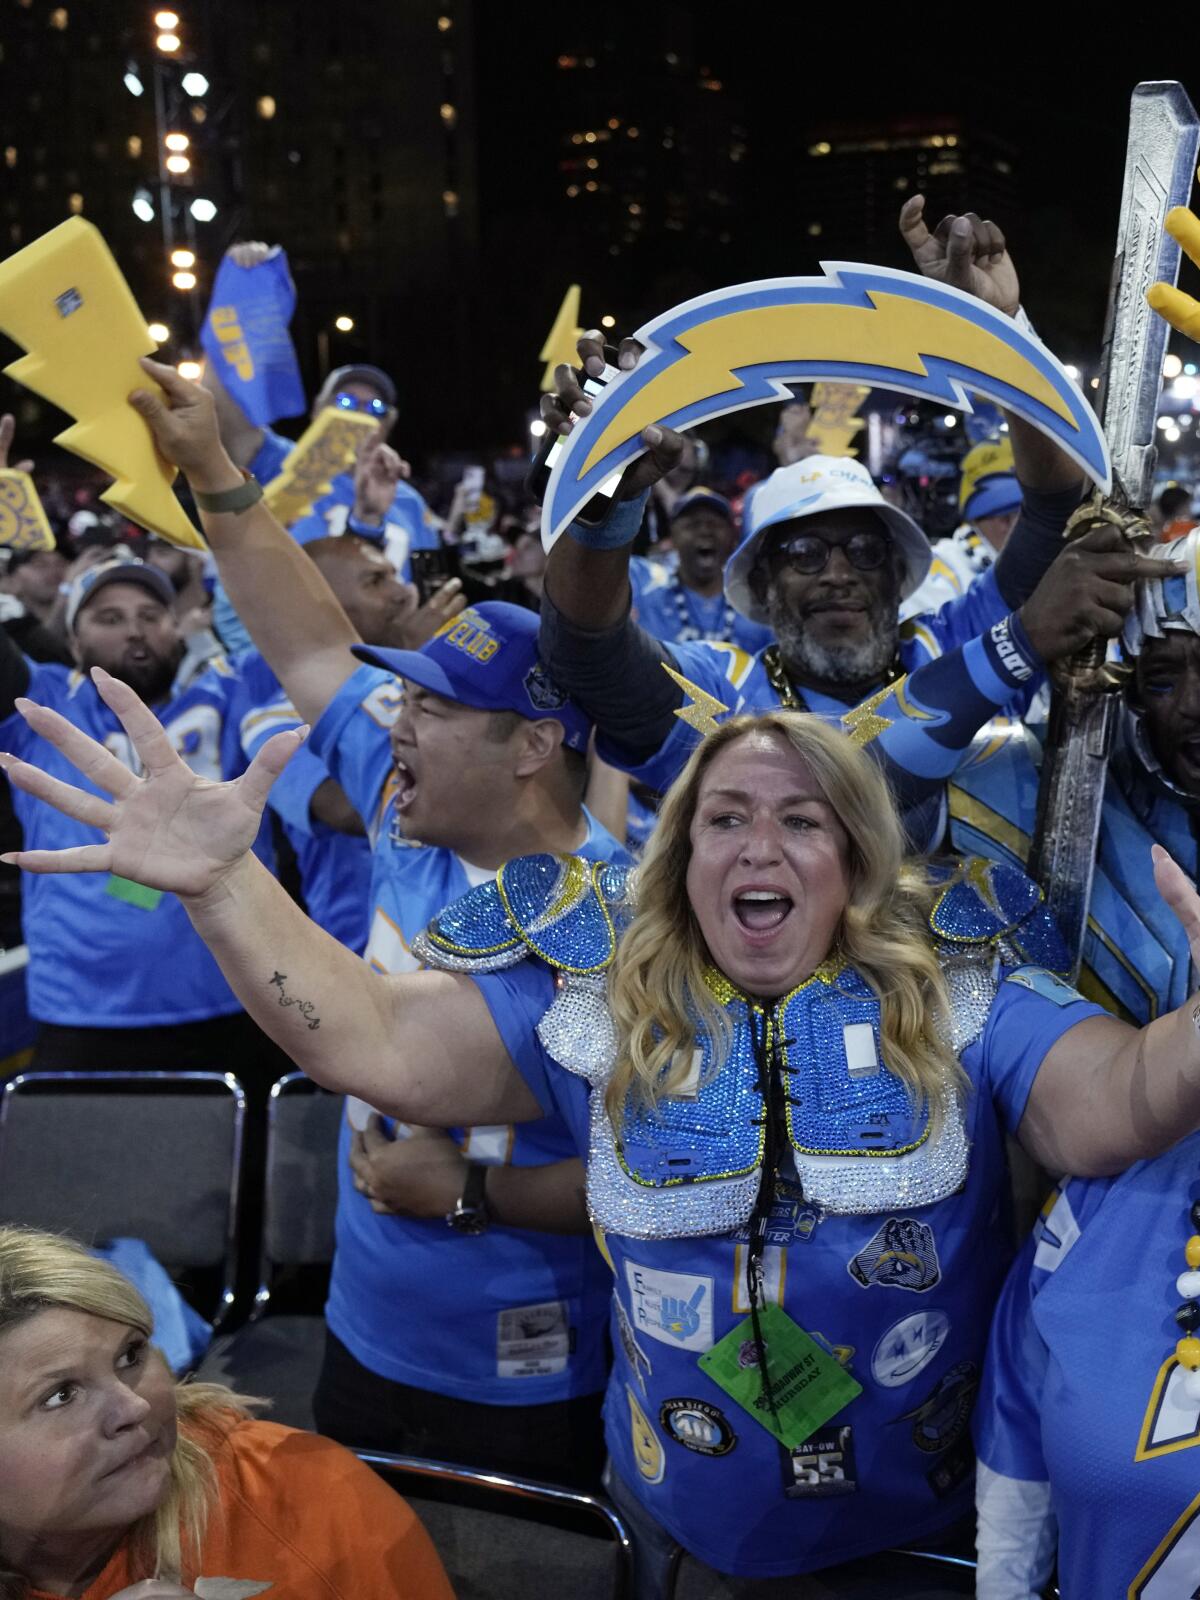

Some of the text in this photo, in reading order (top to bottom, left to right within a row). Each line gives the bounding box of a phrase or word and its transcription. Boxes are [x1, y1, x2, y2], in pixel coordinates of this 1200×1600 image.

[446, 622, 499, 664] CLUB
[803, 1353, 817, 1368] ST
[791, 1451, 845, 1485] 55
